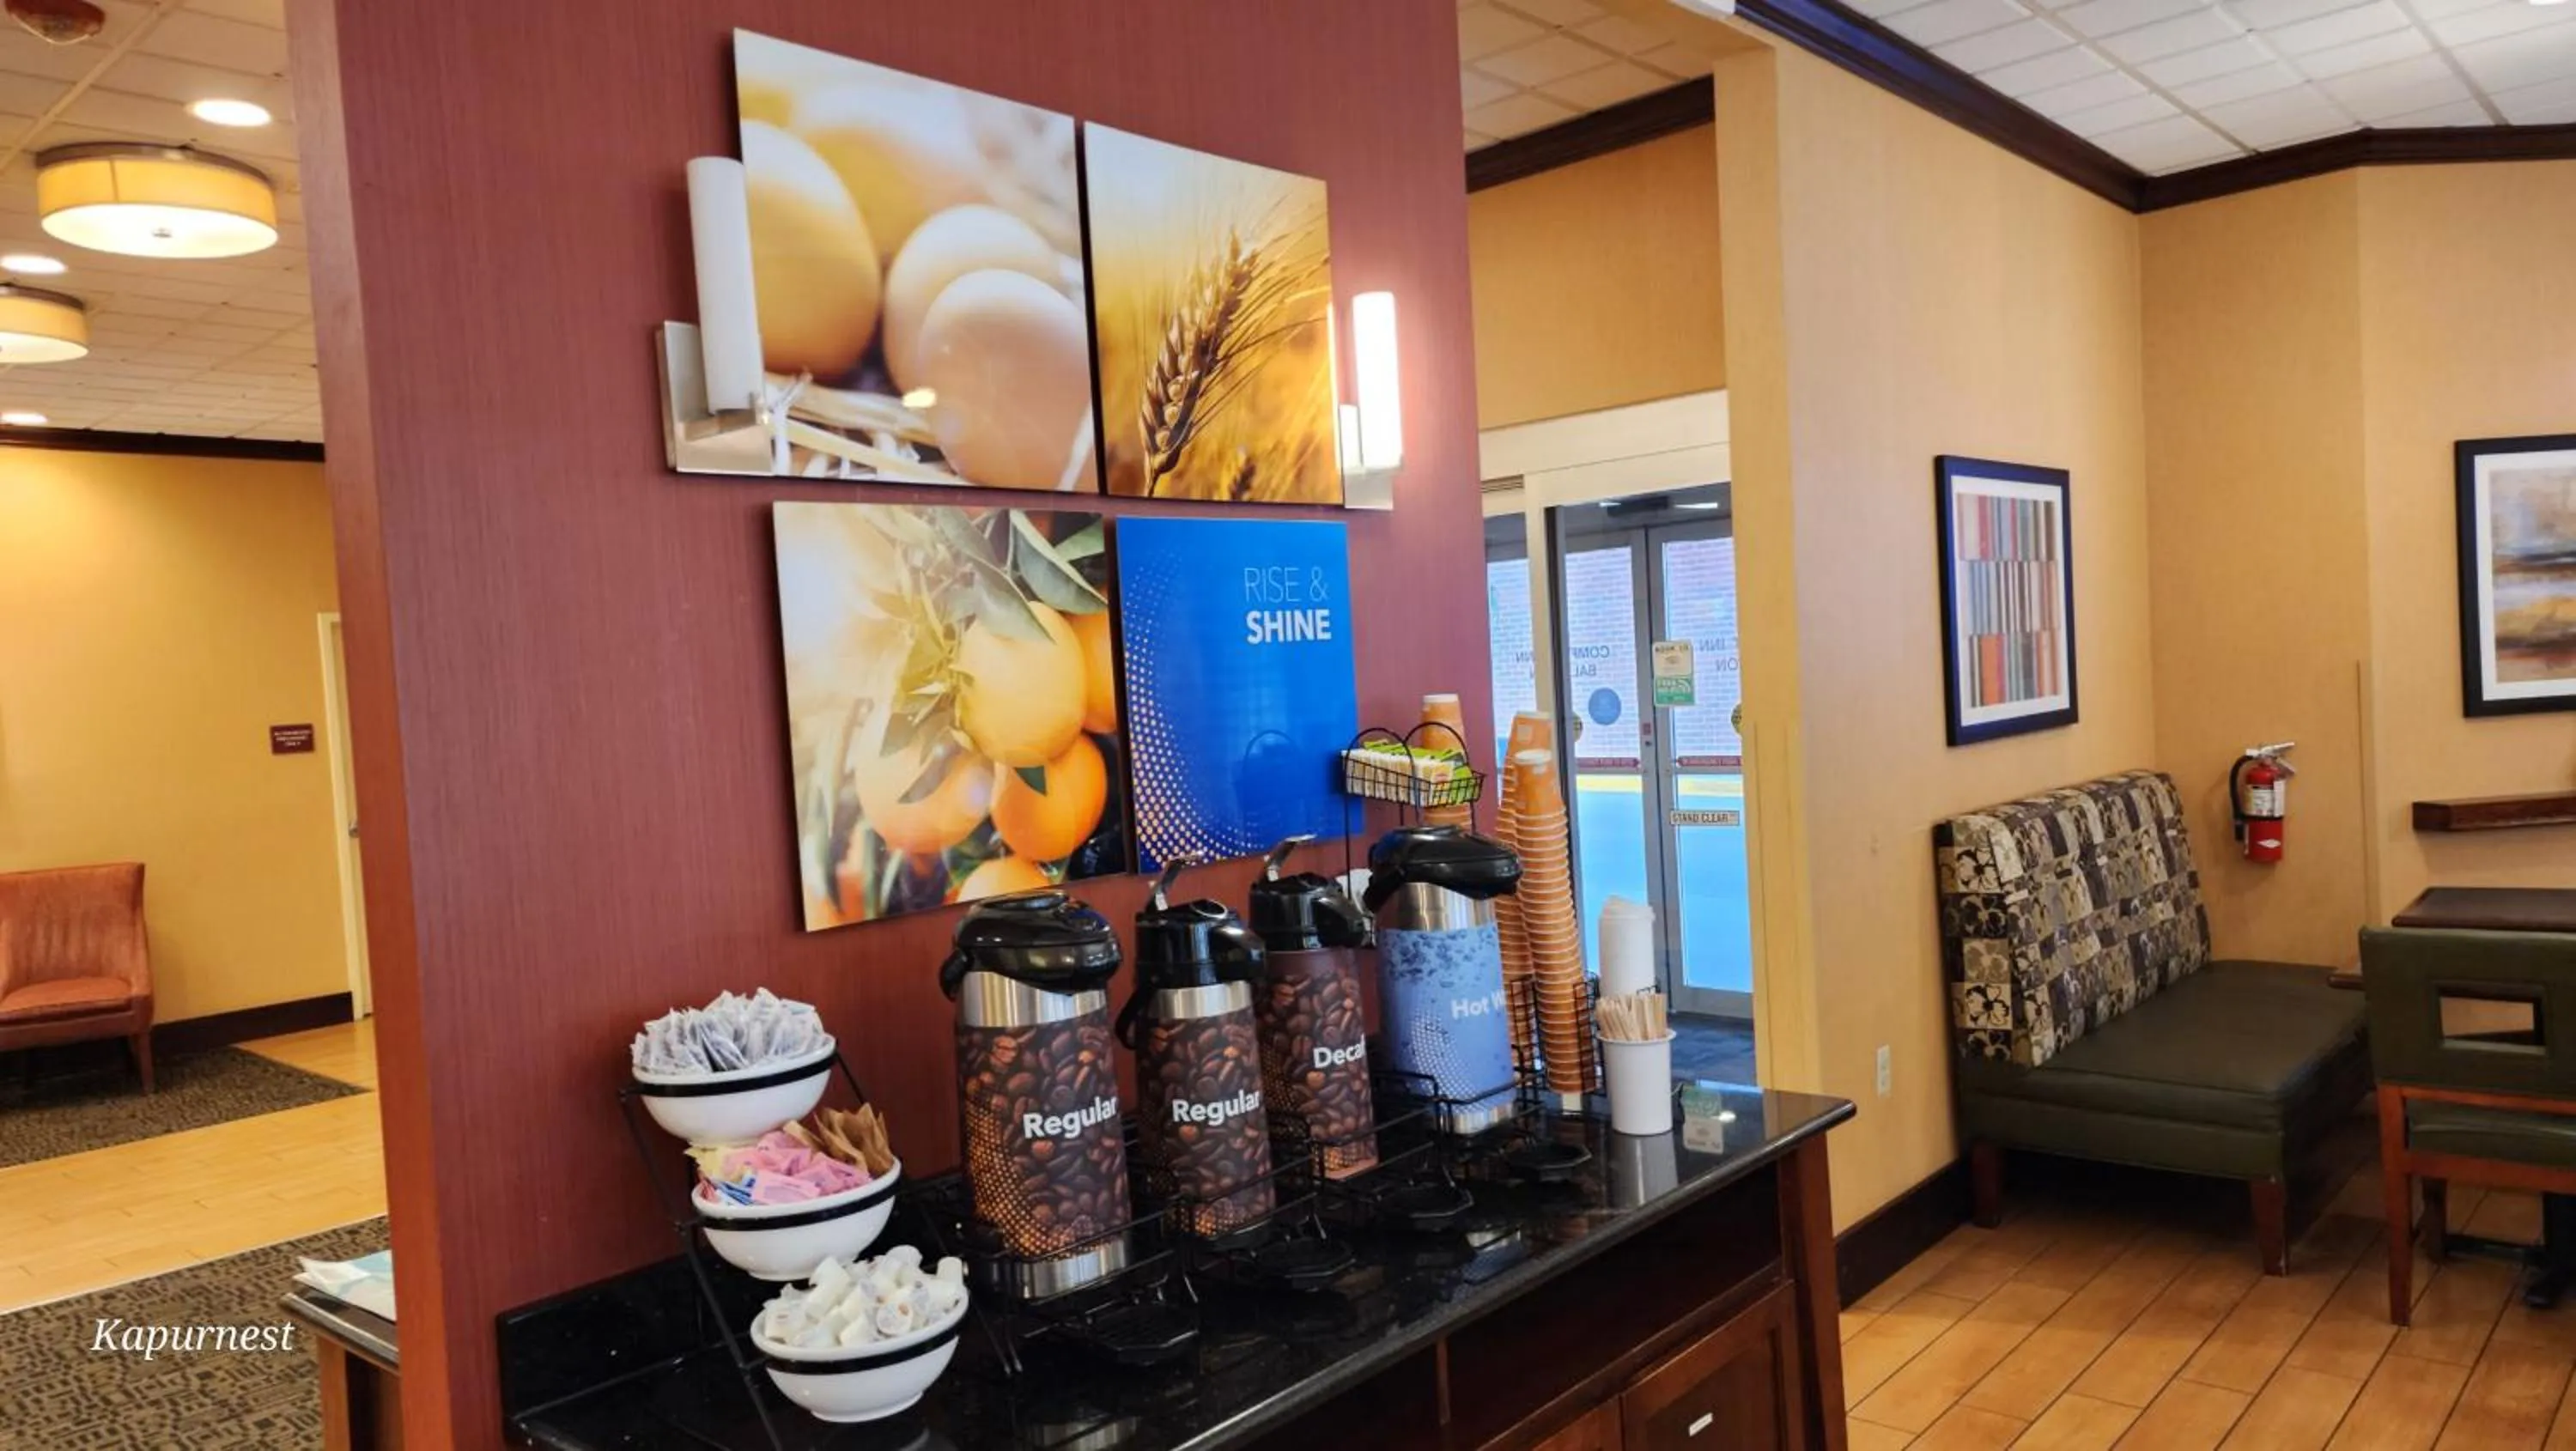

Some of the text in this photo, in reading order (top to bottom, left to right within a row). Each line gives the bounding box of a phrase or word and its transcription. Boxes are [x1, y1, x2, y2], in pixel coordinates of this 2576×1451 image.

[1244, 566, 1328, 603] RISE &
[1246, 609, 1332, 645] SHINE
[1450, 996, 1490, 1020] Hot
[1023, 1096, 1117, 1139] Regular
[1172, 1089, 1260, 1126] Regular
